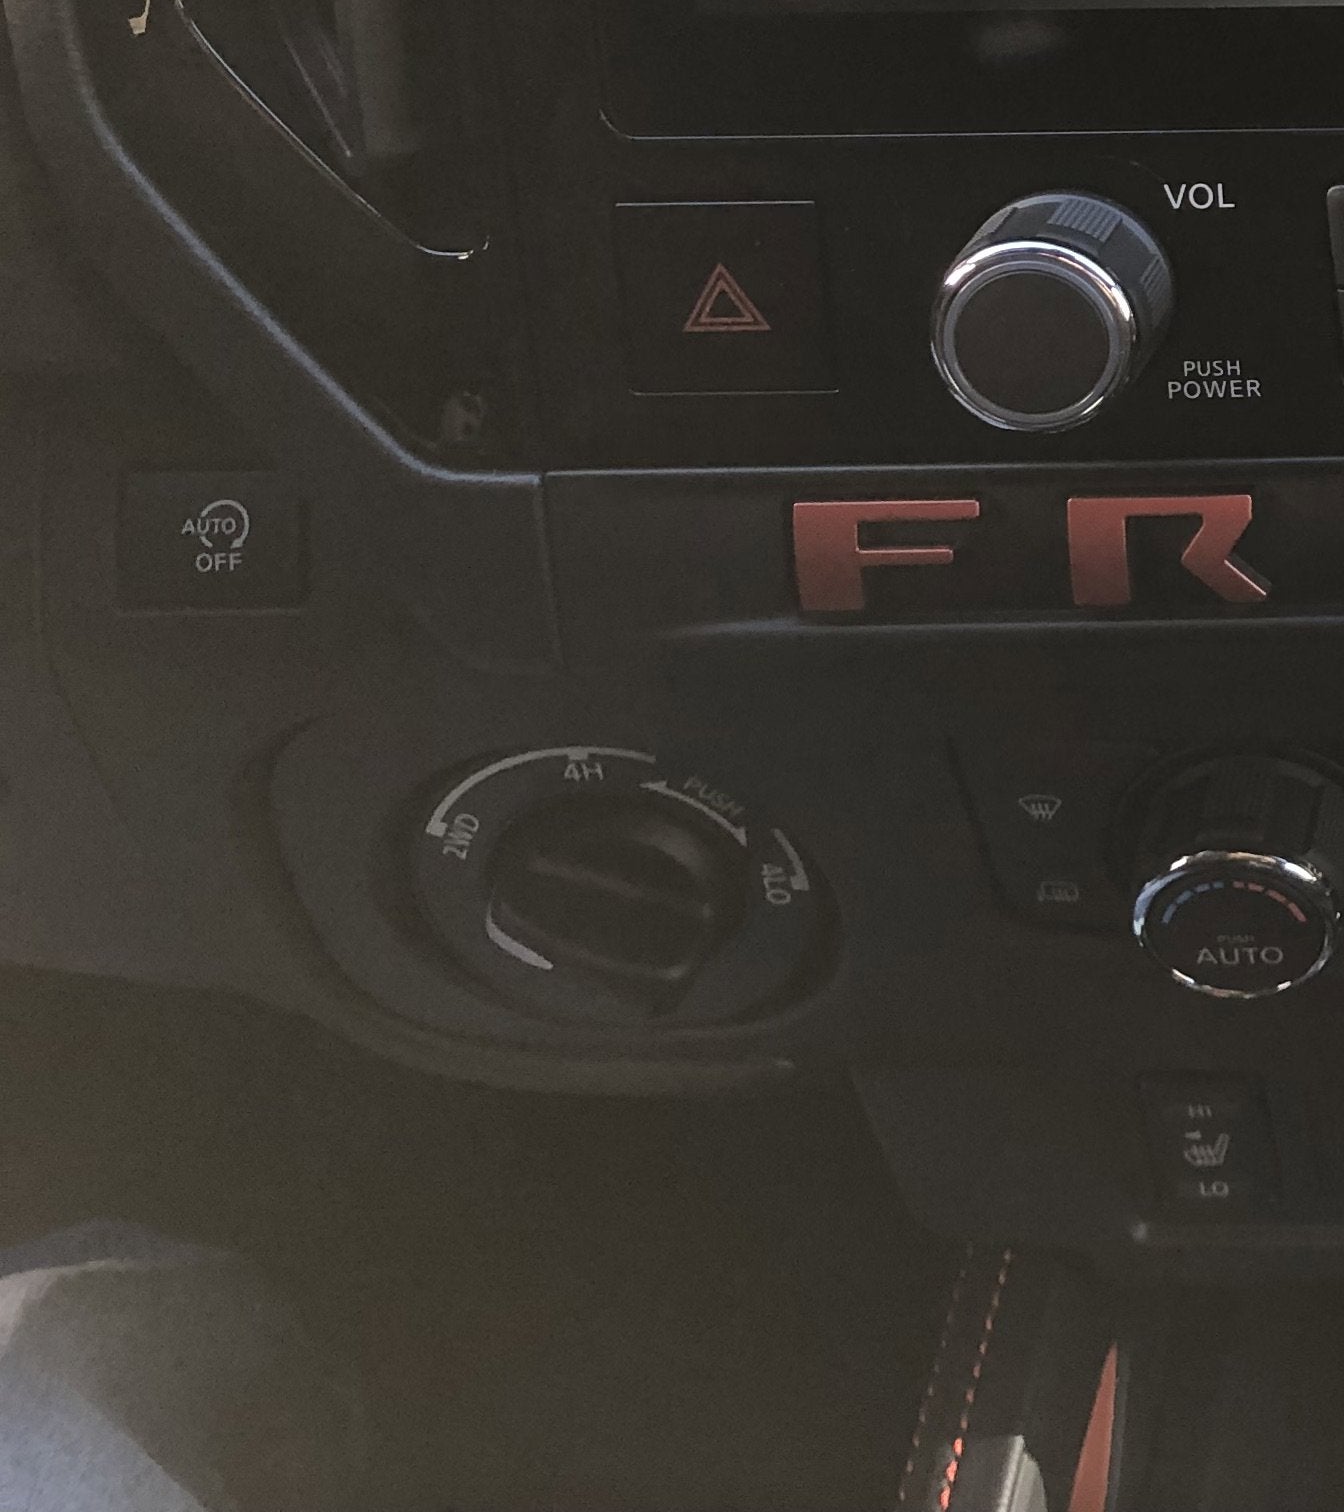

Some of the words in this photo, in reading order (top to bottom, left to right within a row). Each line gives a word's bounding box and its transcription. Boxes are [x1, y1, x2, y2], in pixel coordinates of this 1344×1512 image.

[1163, 182, 1236, 210] VOL
[1182, 360, 1242, 377] PUSH
[1167, 379, 1262, 399] POWER
[181, 516, 238, 537] AUTO
[194, 552, 243, 573] OFF
[563, 761, 604, 782] 4H
[682, 775, 746, 816] PUSH
[442, 812, 480, 861] 2WD
[760, 862, 792, 905] 4LO
[1196, 946, 1285, 966] AUTO
